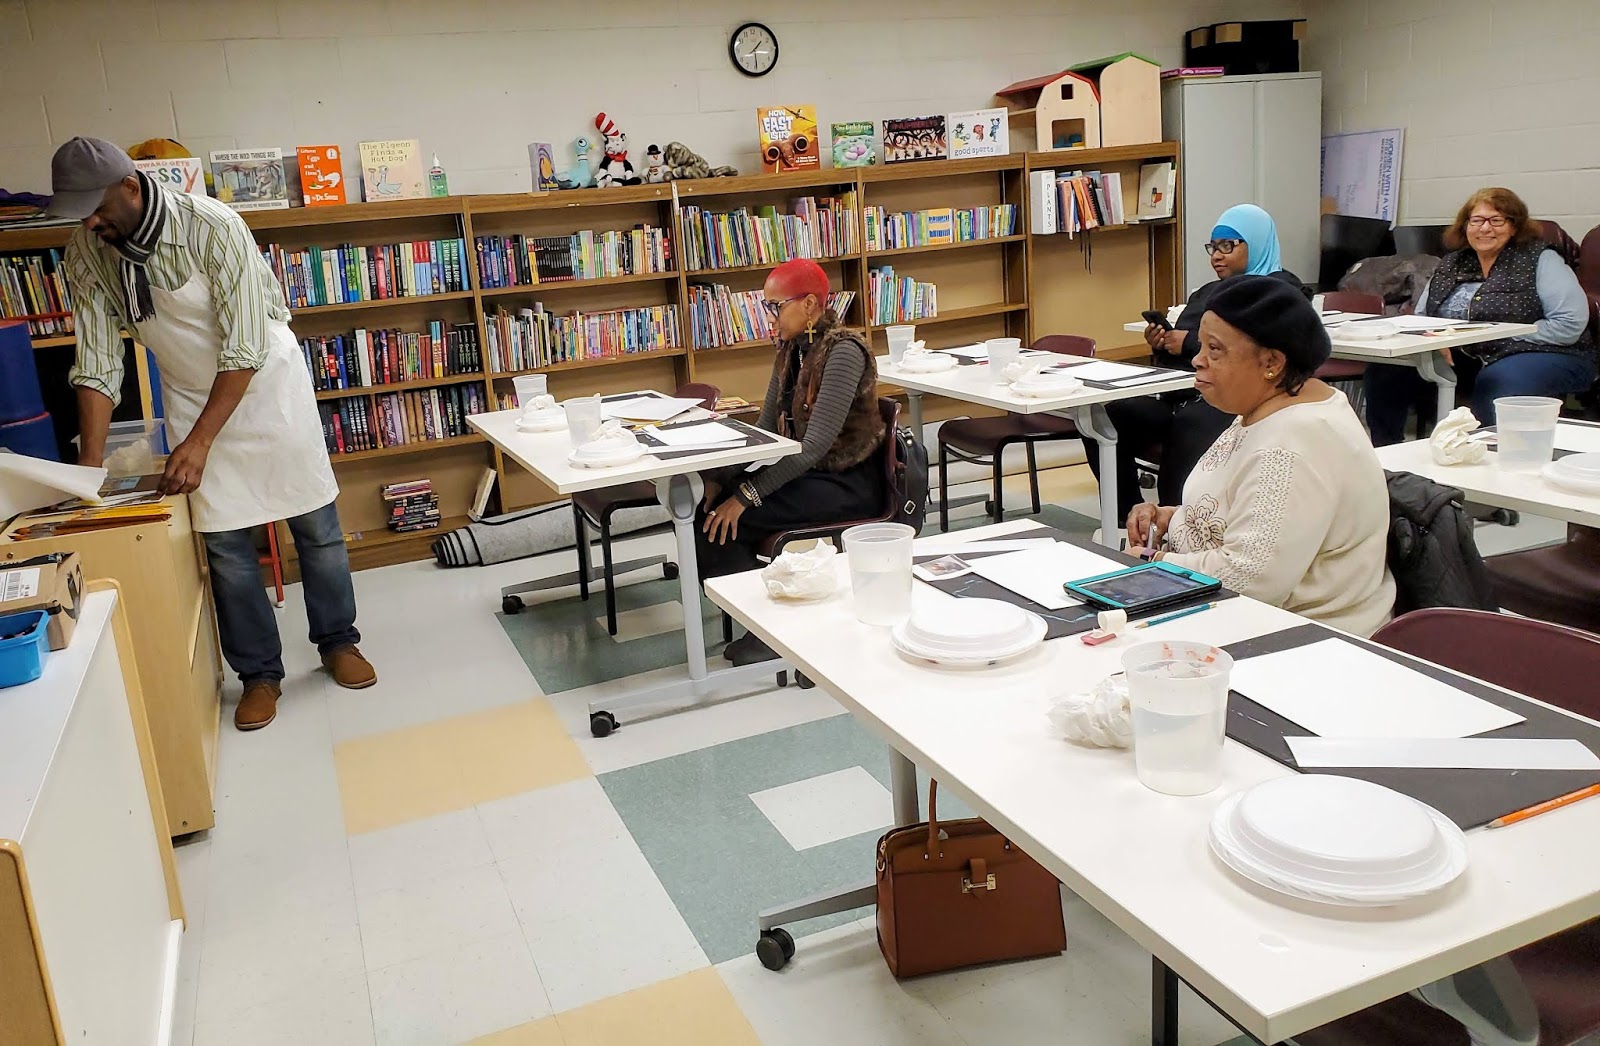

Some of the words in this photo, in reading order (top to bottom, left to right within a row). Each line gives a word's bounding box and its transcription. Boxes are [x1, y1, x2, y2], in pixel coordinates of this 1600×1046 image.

[768, 110, 786, 118] HOW
[762, 116, 794, 132] FAST
[381, 142, 411, 150] Pigeon
[954, 147, 971, 157] good
[971, 146, 995, 155] sports
[1385, 137, 1394, 173] WOMEN
[136, 161, 168, 169] DWARD
[1383, 173, 1391, 196] WITH
